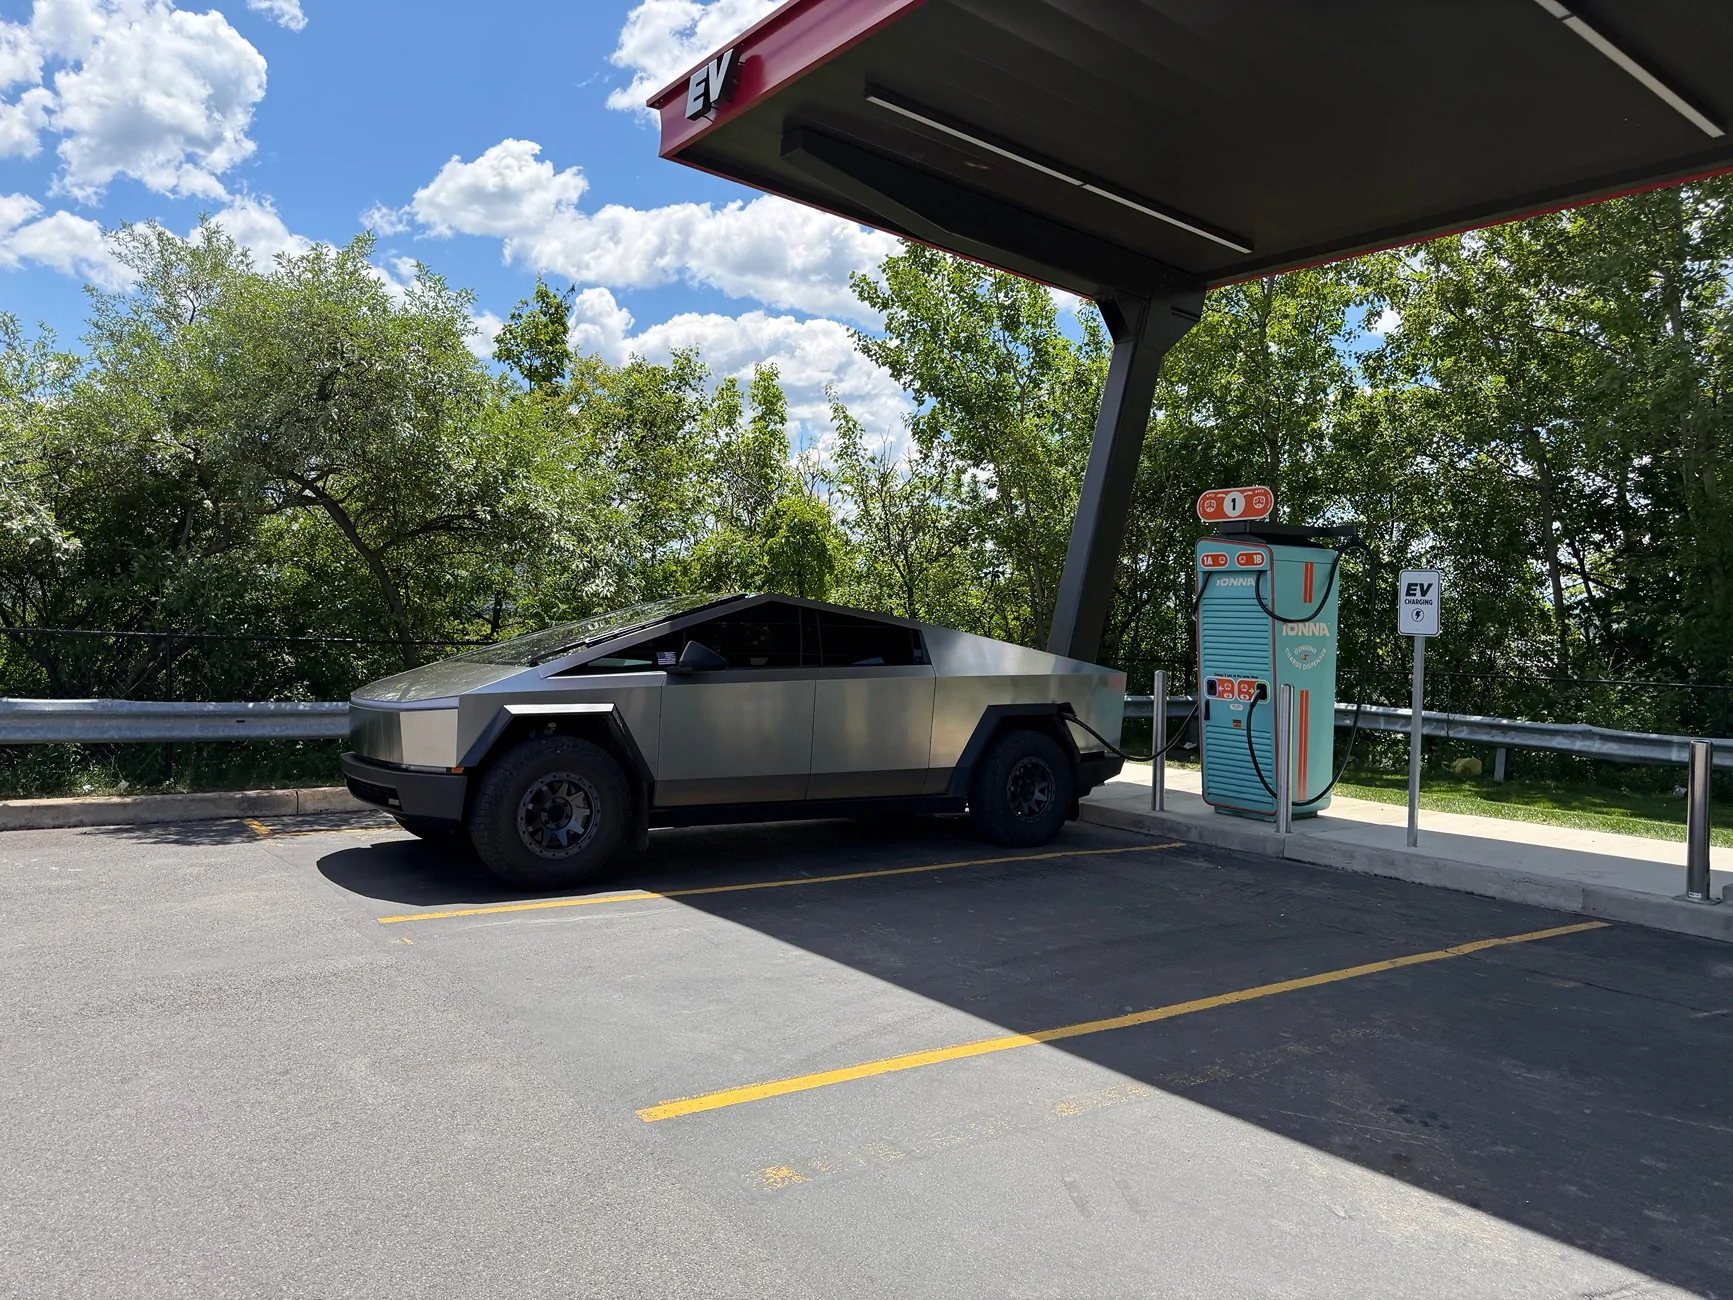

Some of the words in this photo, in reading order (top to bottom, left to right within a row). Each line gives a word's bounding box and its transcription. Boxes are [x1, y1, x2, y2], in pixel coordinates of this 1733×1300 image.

[684, 48, 735, 119] EV
[1231, 497, 1237, 511] 1
[1203, 556, 1213, 565] 1A
[1253, 554, 1263, 564] 1B
[1405, 582, 1433, 597] EV
[1404, 598, 1433, 606] CHARGING
[1294, 644, 1318, 655] GENUINE
[1285, 647, 1302, 670] CHARGE
[1303, 647, 1327, 670] DISPENSER
